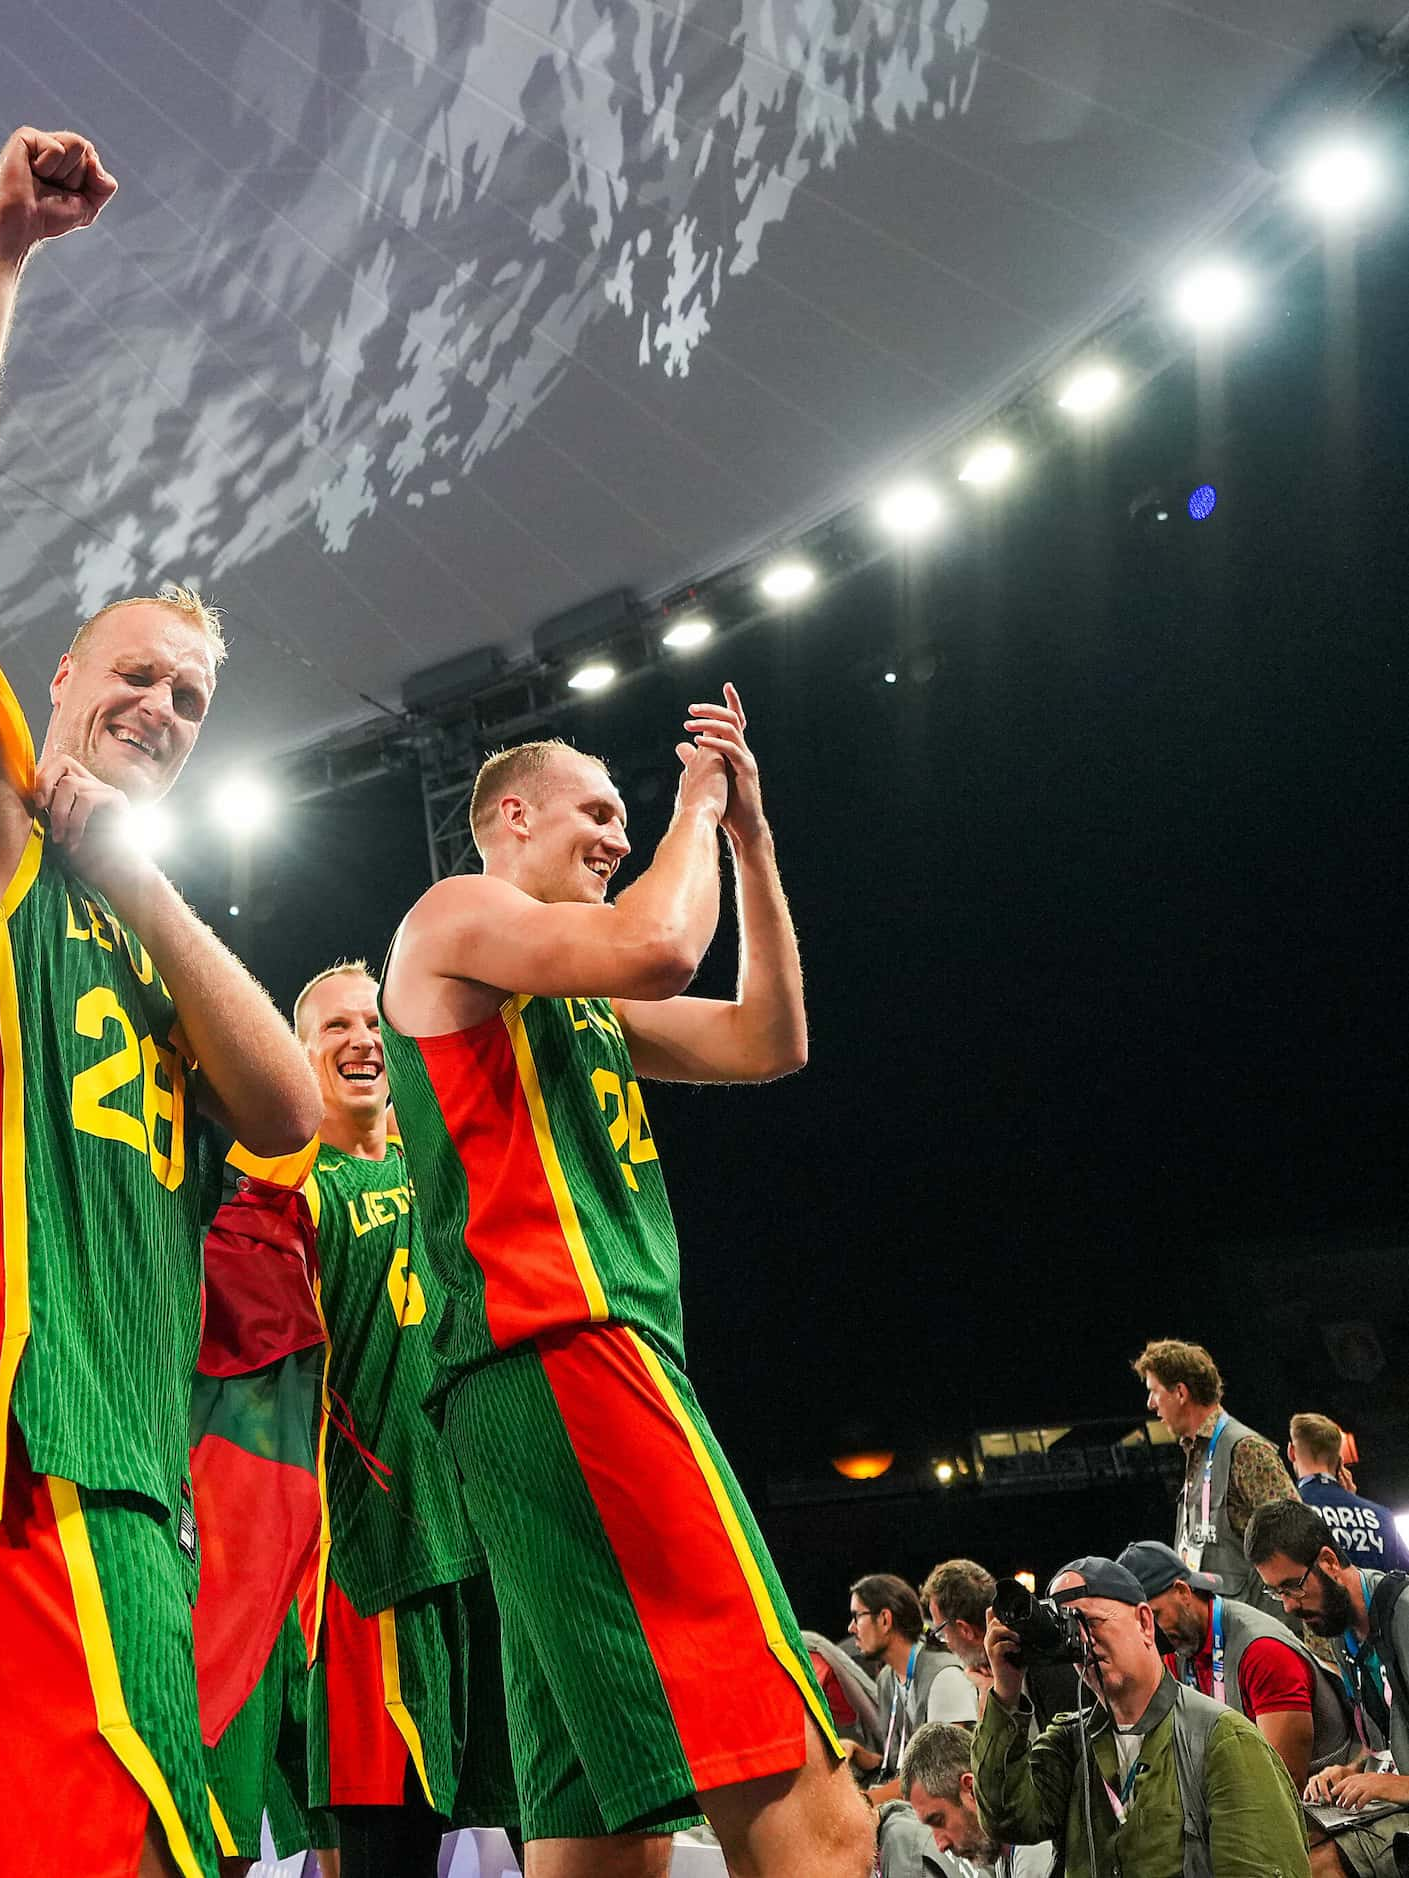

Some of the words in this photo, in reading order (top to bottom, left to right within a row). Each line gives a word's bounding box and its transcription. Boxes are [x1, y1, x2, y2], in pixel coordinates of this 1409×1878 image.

[71, 986, 185, 1192] 28
[591, 1067, 660, 1192] 24
[387, 1248, 427, 1328] 6
[1332, 1527, 1384, 1554] 024
